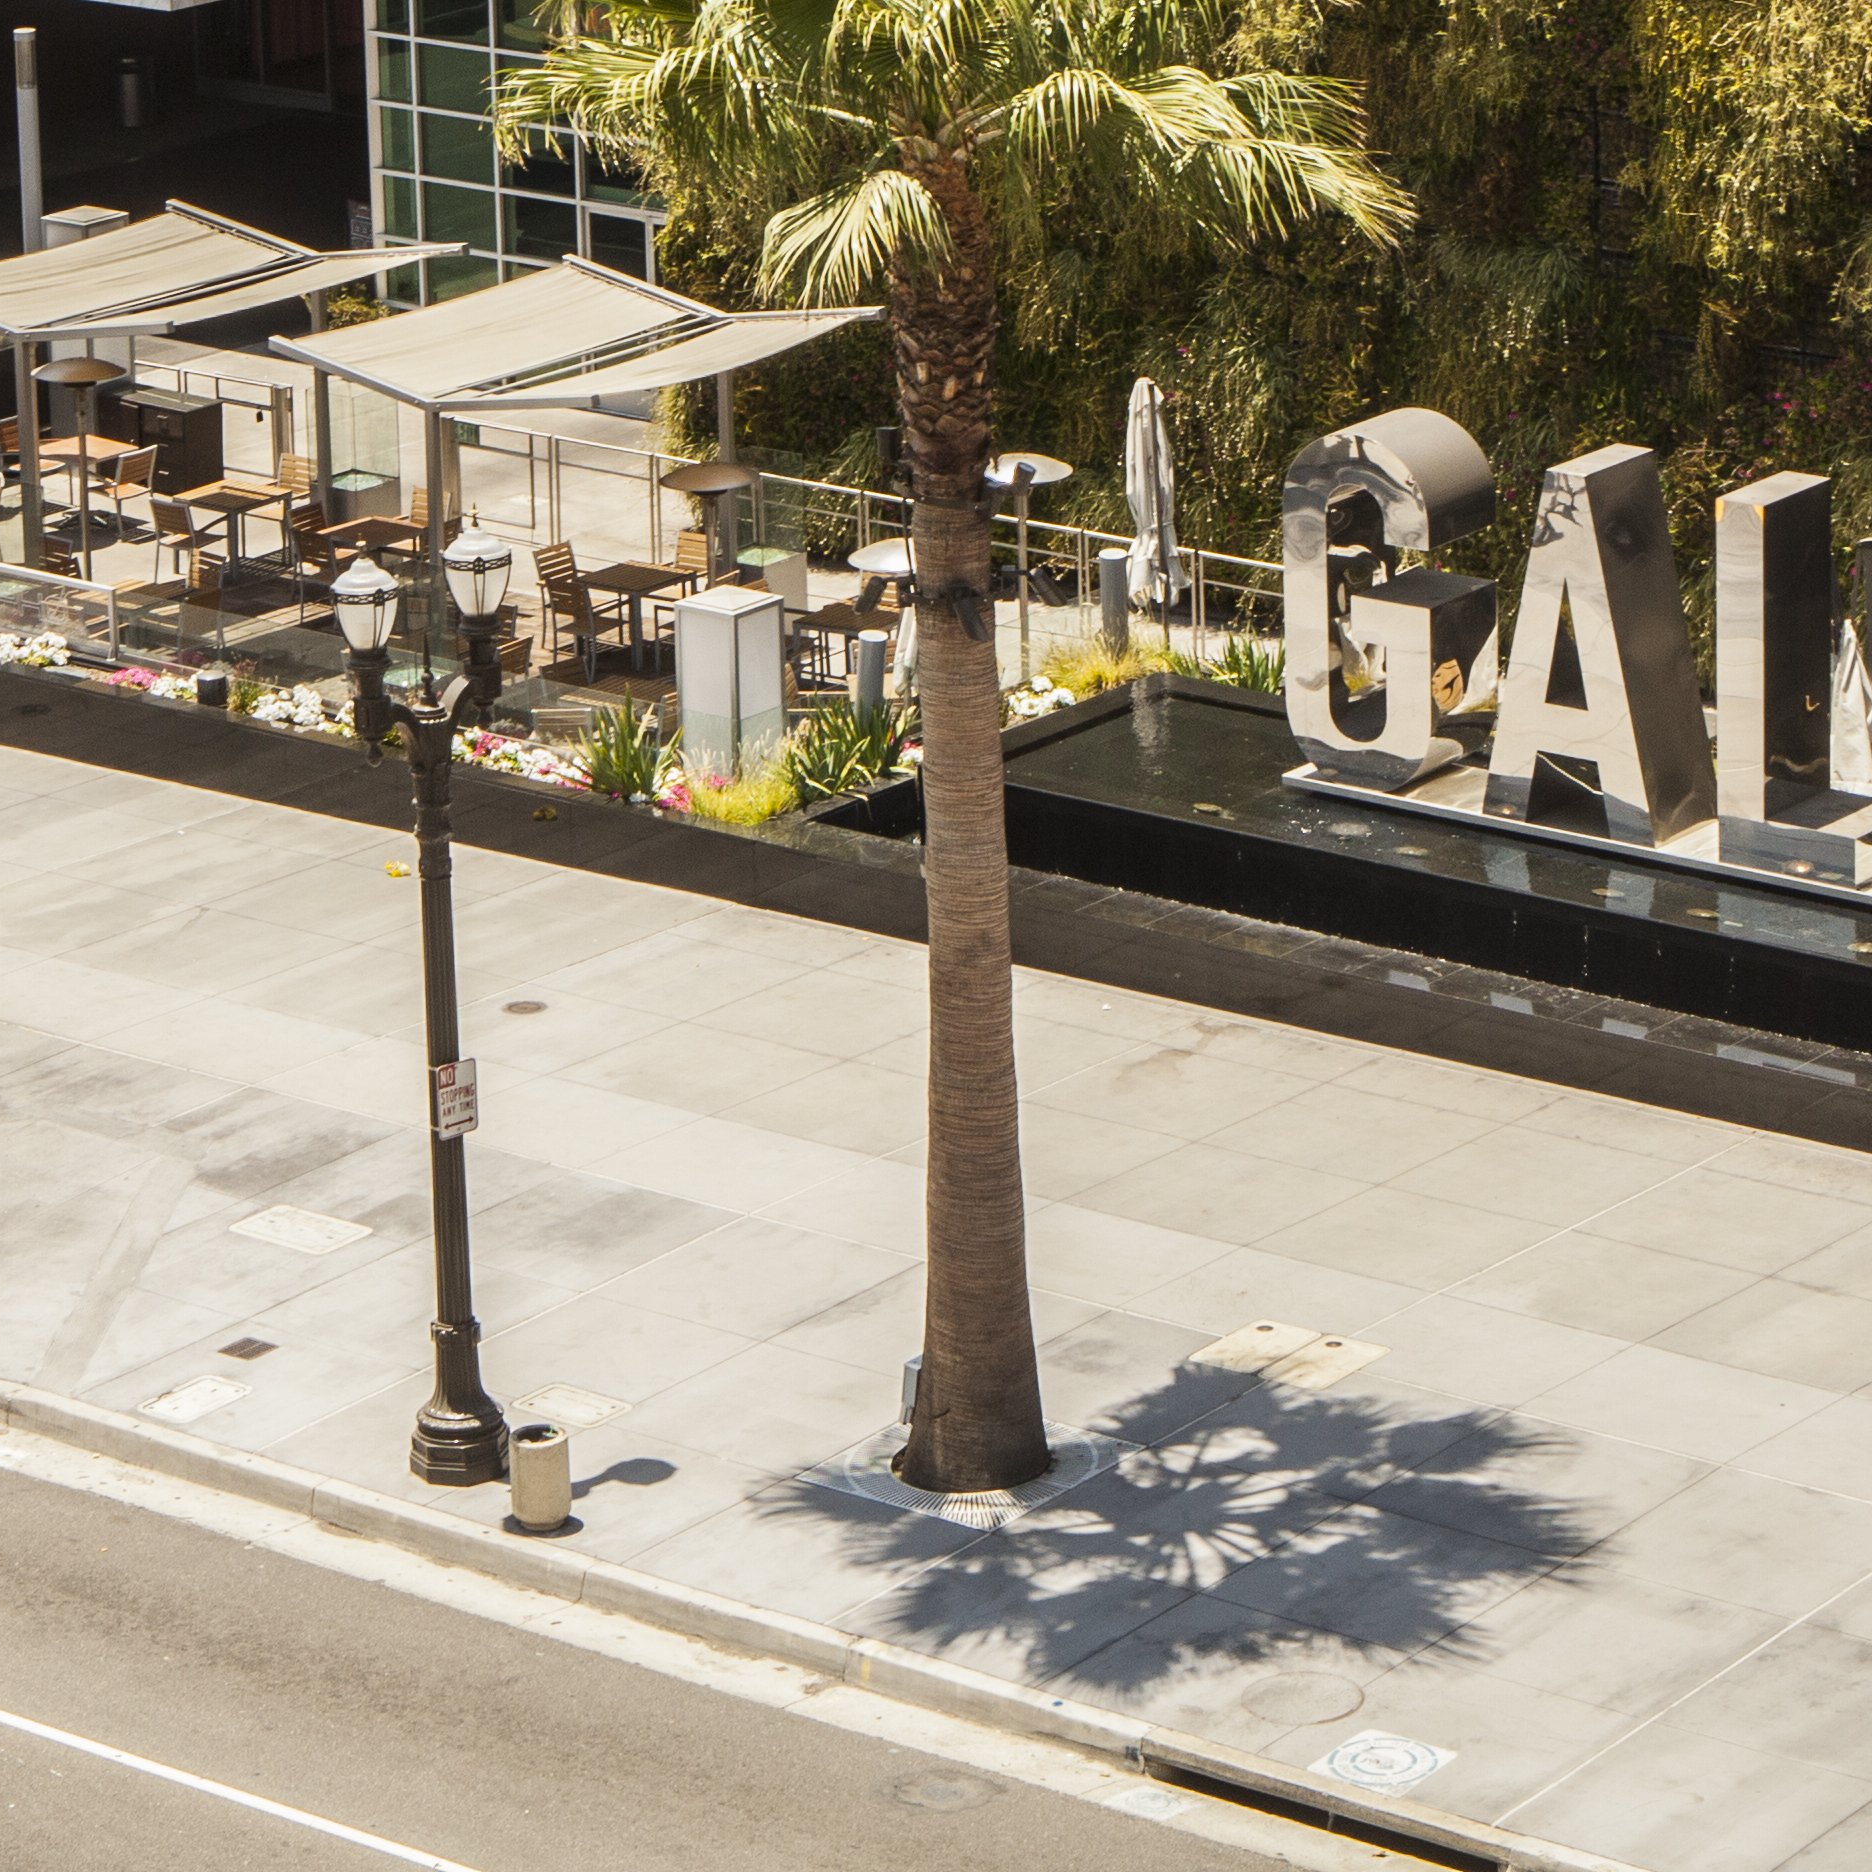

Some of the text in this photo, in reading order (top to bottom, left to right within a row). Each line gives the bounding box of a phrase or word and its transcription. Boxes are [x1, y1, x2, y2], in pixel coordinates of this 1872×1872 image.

[439, 1067, 454, 1087] NO
[441, 1083, 475, 1106] STOPPING
[442, 1098, 474, 1118] ANY TIME
